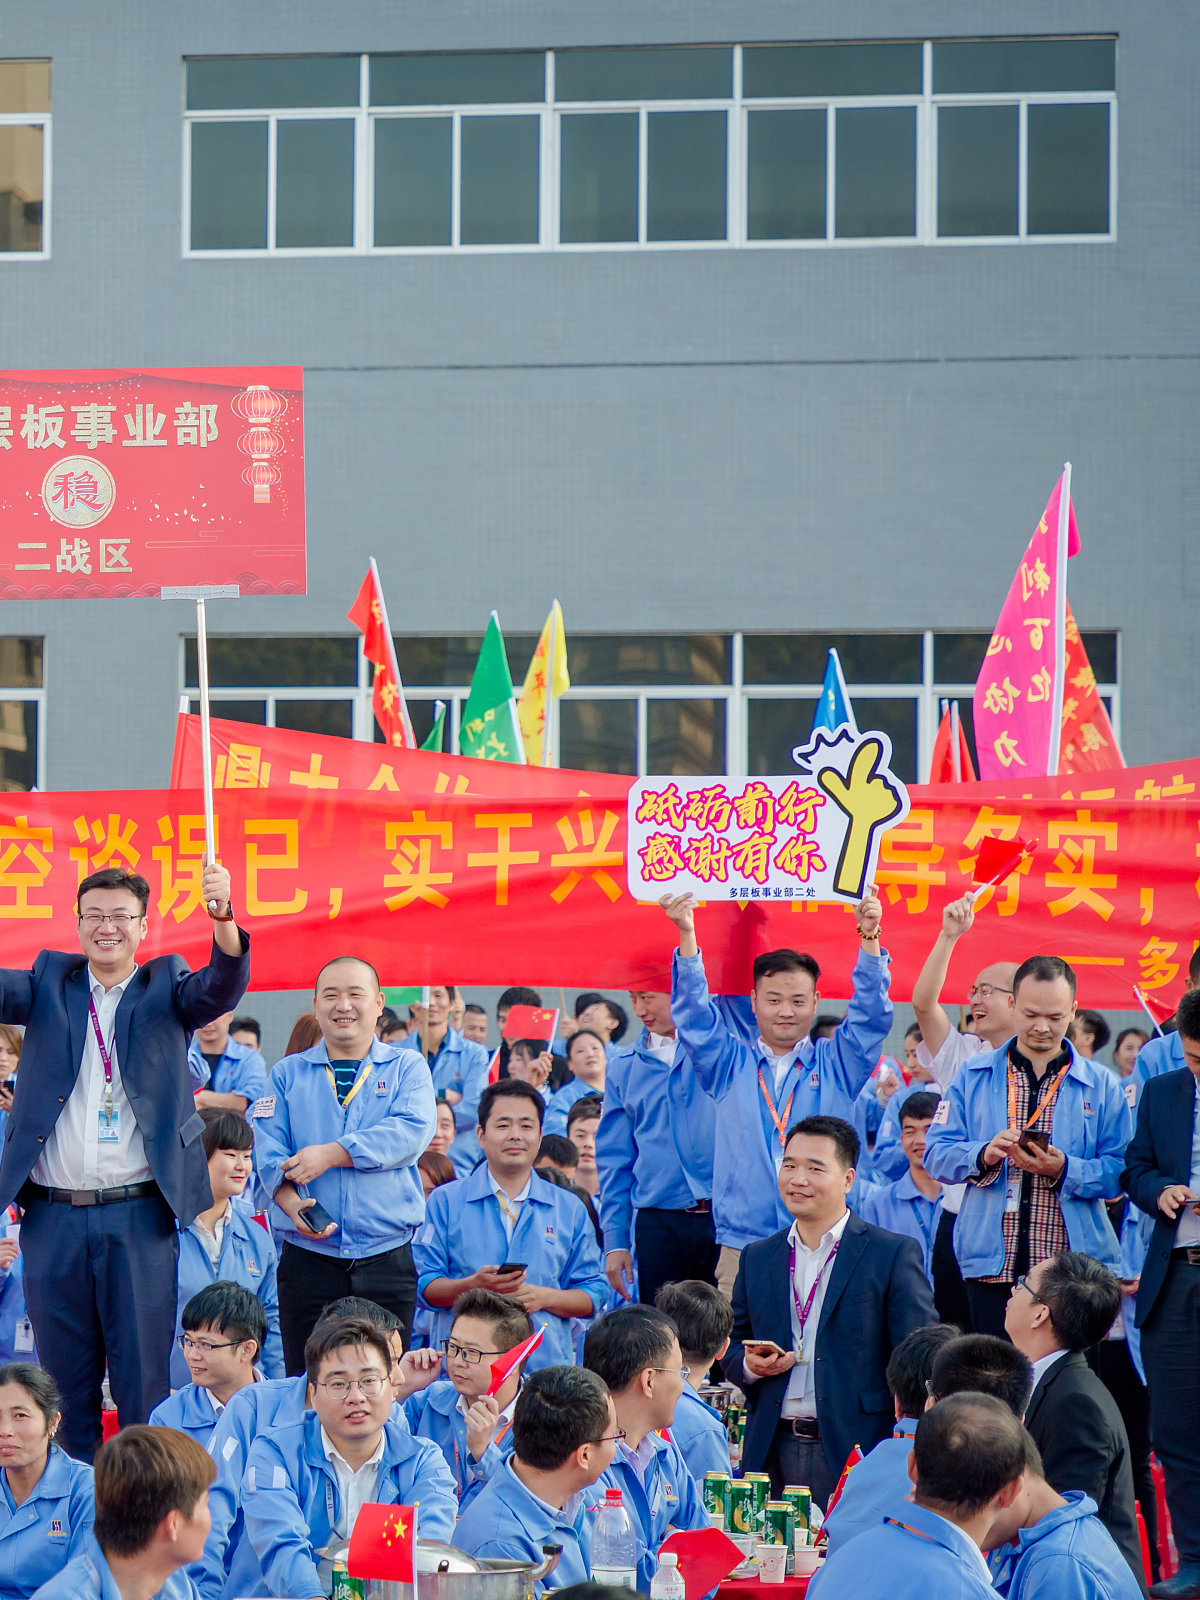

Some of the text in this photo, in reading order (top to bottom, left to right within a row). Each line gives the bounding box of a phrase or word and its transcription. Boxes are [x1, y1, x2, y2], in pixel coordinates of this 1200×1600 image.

[51, 469, 106, 513] 稳
[14, 538, 133, 575] 二战区
[637, 781, 826, 834] 砥砺前行
[638, 832, 827, 883] 感谢有你
[729, 886, 816, 898] 多层板事业部二处
